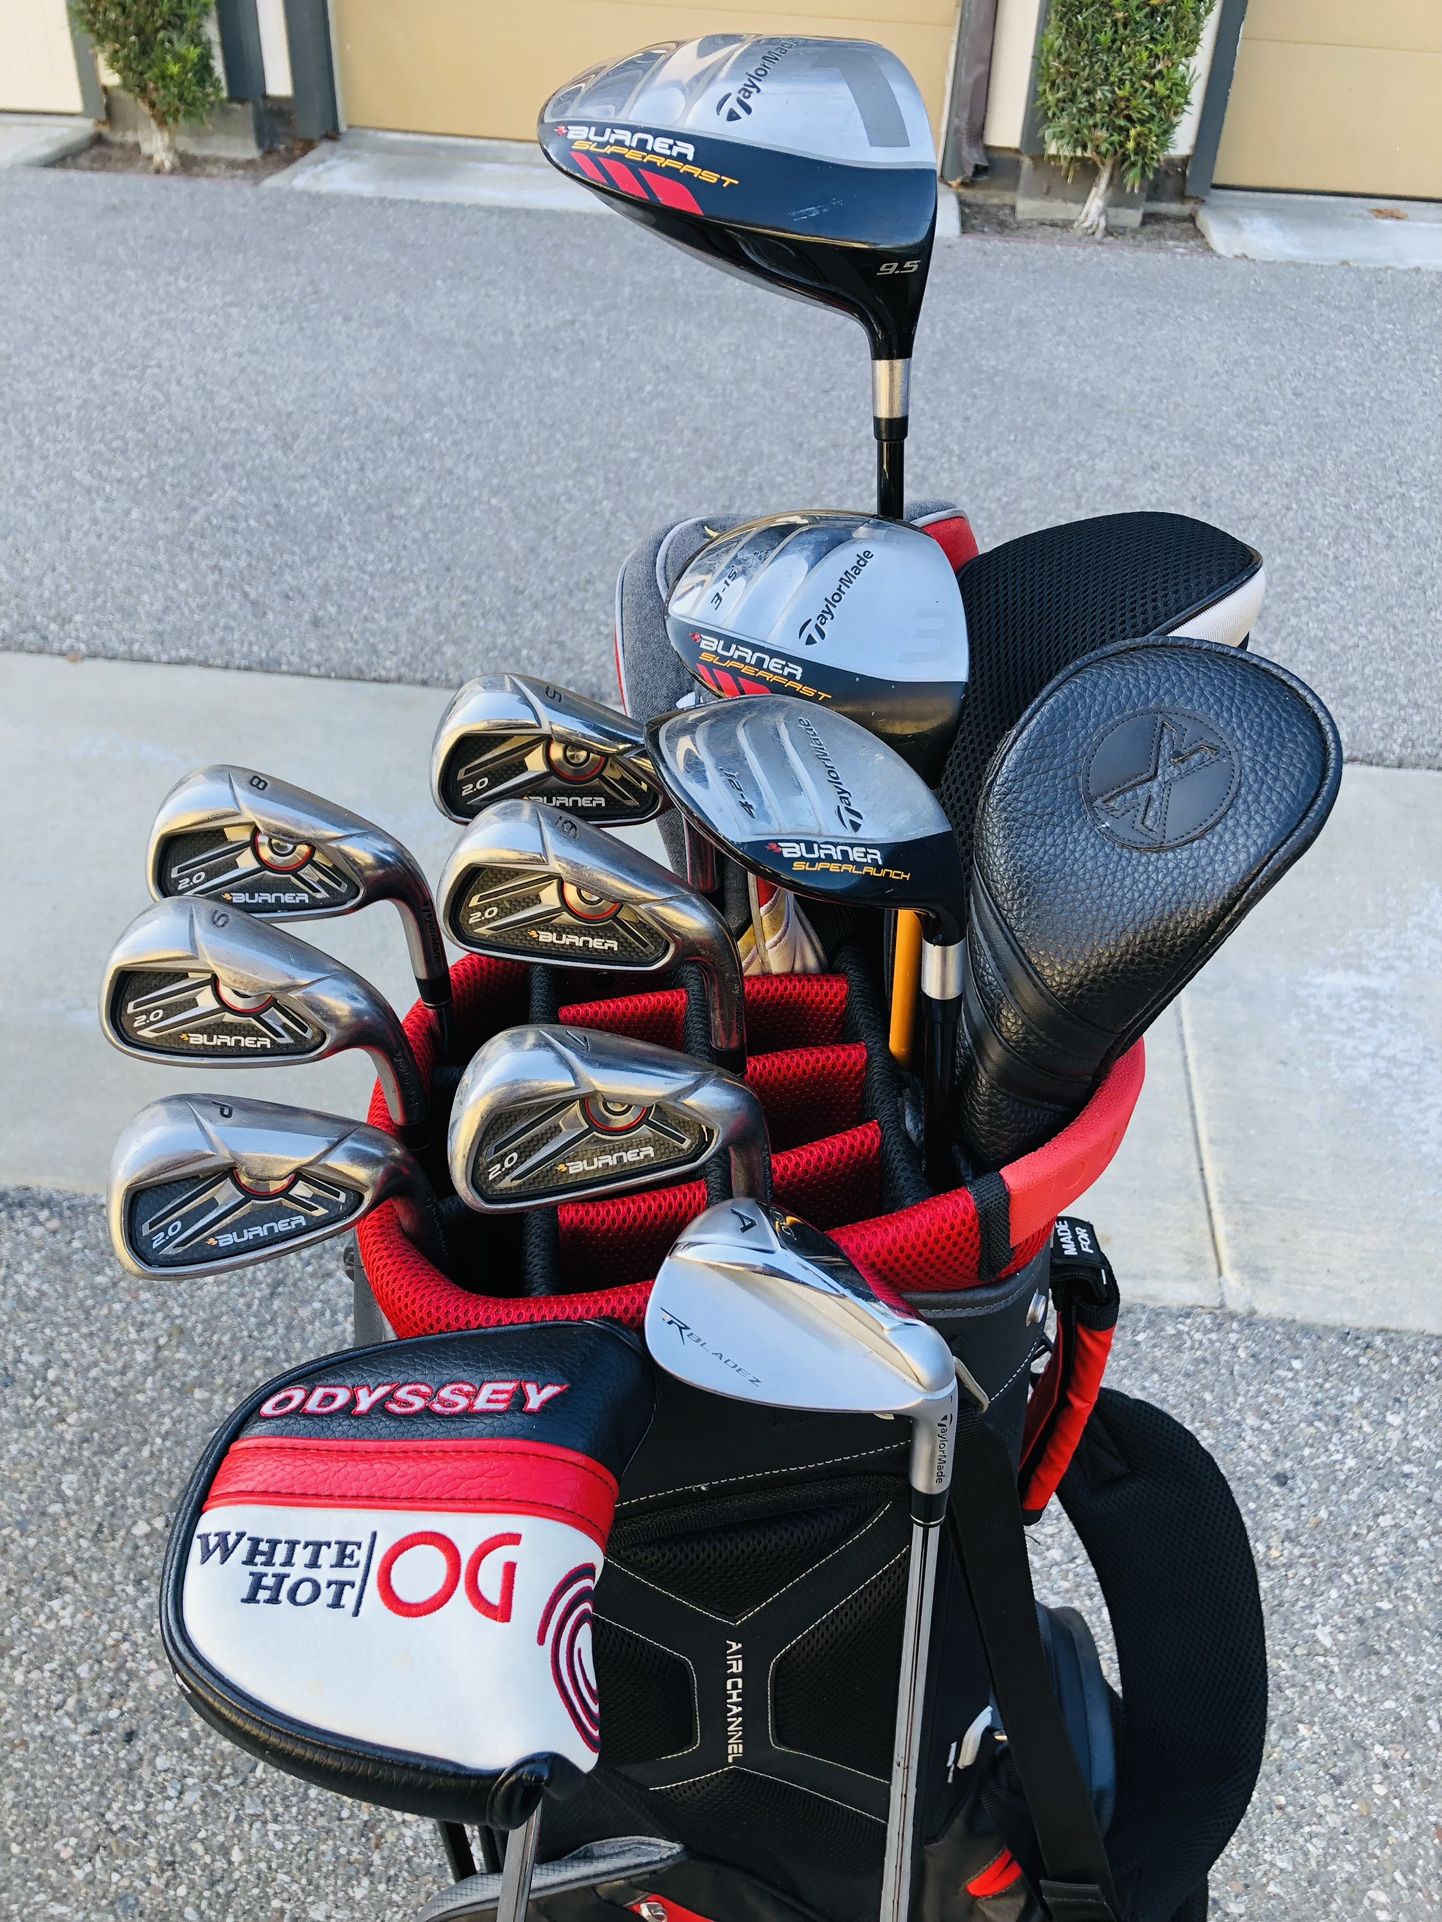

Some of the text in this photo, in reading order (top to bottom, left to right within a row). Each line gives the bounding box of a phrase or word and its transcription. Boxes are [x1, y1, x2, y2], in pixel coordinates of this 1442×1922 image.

[566, 125, 695, 161] BURNER
[571, 140, 739, 188] SUPERFAST
[876, 260, 921, 277] 9.5
[799, 549, 874, 646] TaylorMade
[699, 633, 804, 681] BURNER
[699, 651, 832, 701] SUPERFAST
[249, 775, 268, 791] 8
[461, 776, 489, 796] 2.0
[778, 842, 884, 866] BURNER
[177, 871, 206, 890] 2.0
[792, 860, 911, 881] SUPERLAUNCH
[230, 892, 309, 904] BURNER
[468, 906, 498, 924] 2.0
[538, 931, 618, 951] BURNER
[133, 1009, 163, 1027] 2.0
[187, 1033, 271, 1048] BURNER
[211, 1101, 233, 1119] P
[487, 1151, 518, 1180] 2.0
[566, 1146, 655, 1174] BURNER
[151, 1220, 182, 1249] 2.0
[215, 1215, 306, 1247] BURNER
[730, 1208, 757, 1234] A
[1055, 1220, 1078, 1256] MADE
[1075, 1226, 1094, 1254] FOR
[259, 1380, 569, 1417] ODYSSEY
[935, 1413, 953, 1484] TaylorMade
[196, 1530, 362, 1569] WHITE
[240, 1571, 358, 1609] HOT
[376, 1530, 522, 1623] OG
[726, 1640, 743, 1763] AIR CHANNEL
